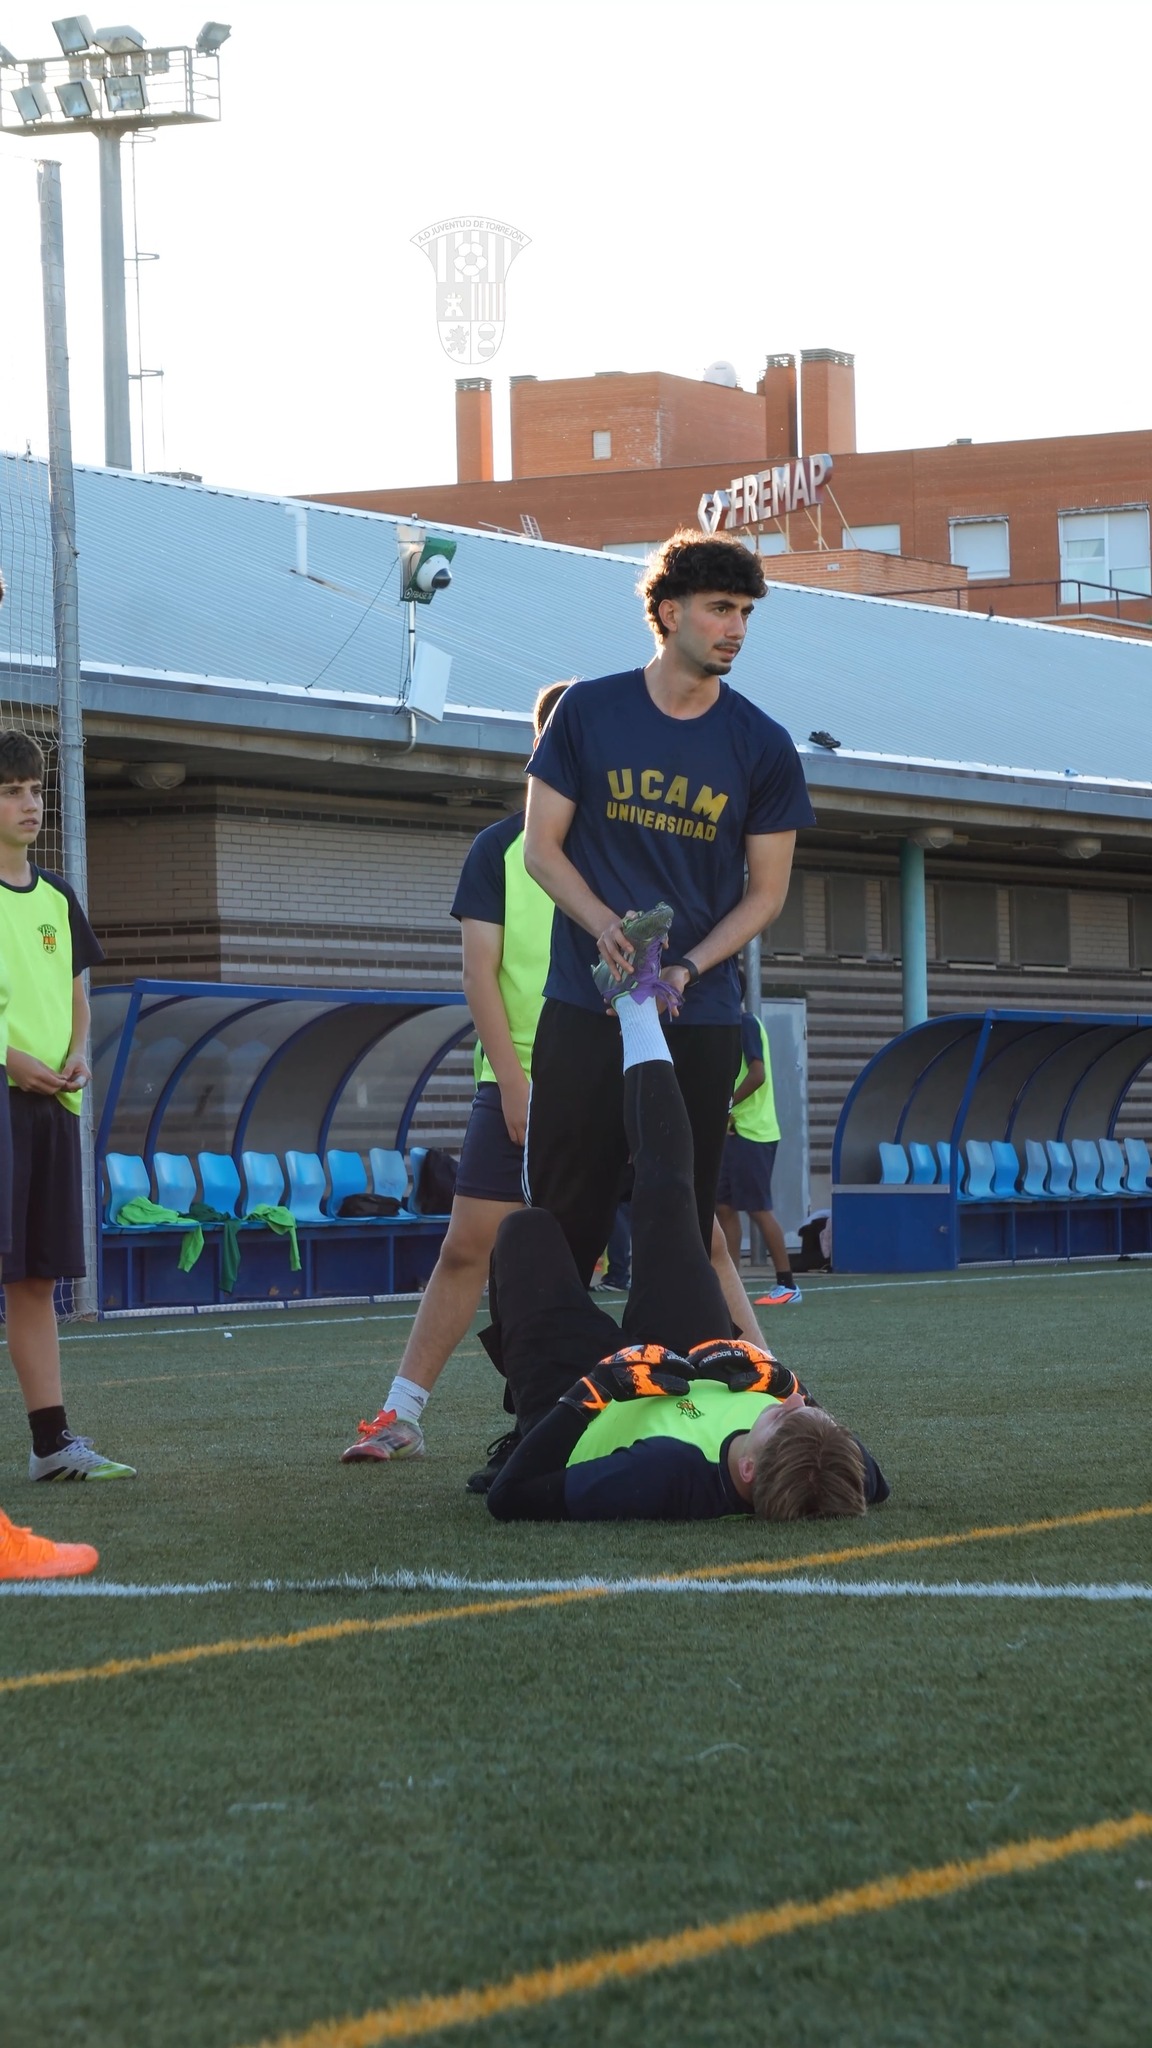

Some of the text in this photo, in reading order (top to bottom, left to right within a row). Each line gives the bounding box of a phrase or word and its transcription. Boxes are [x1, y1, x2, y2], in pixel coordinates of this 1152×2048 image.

[728, 453, 833, 529] FREMAP
[607, 768, 729, 823] UCAM
[606, 801, 717, 842] UNIVERSIDAD
[702, 1350, 732, 1364] SOCCER
